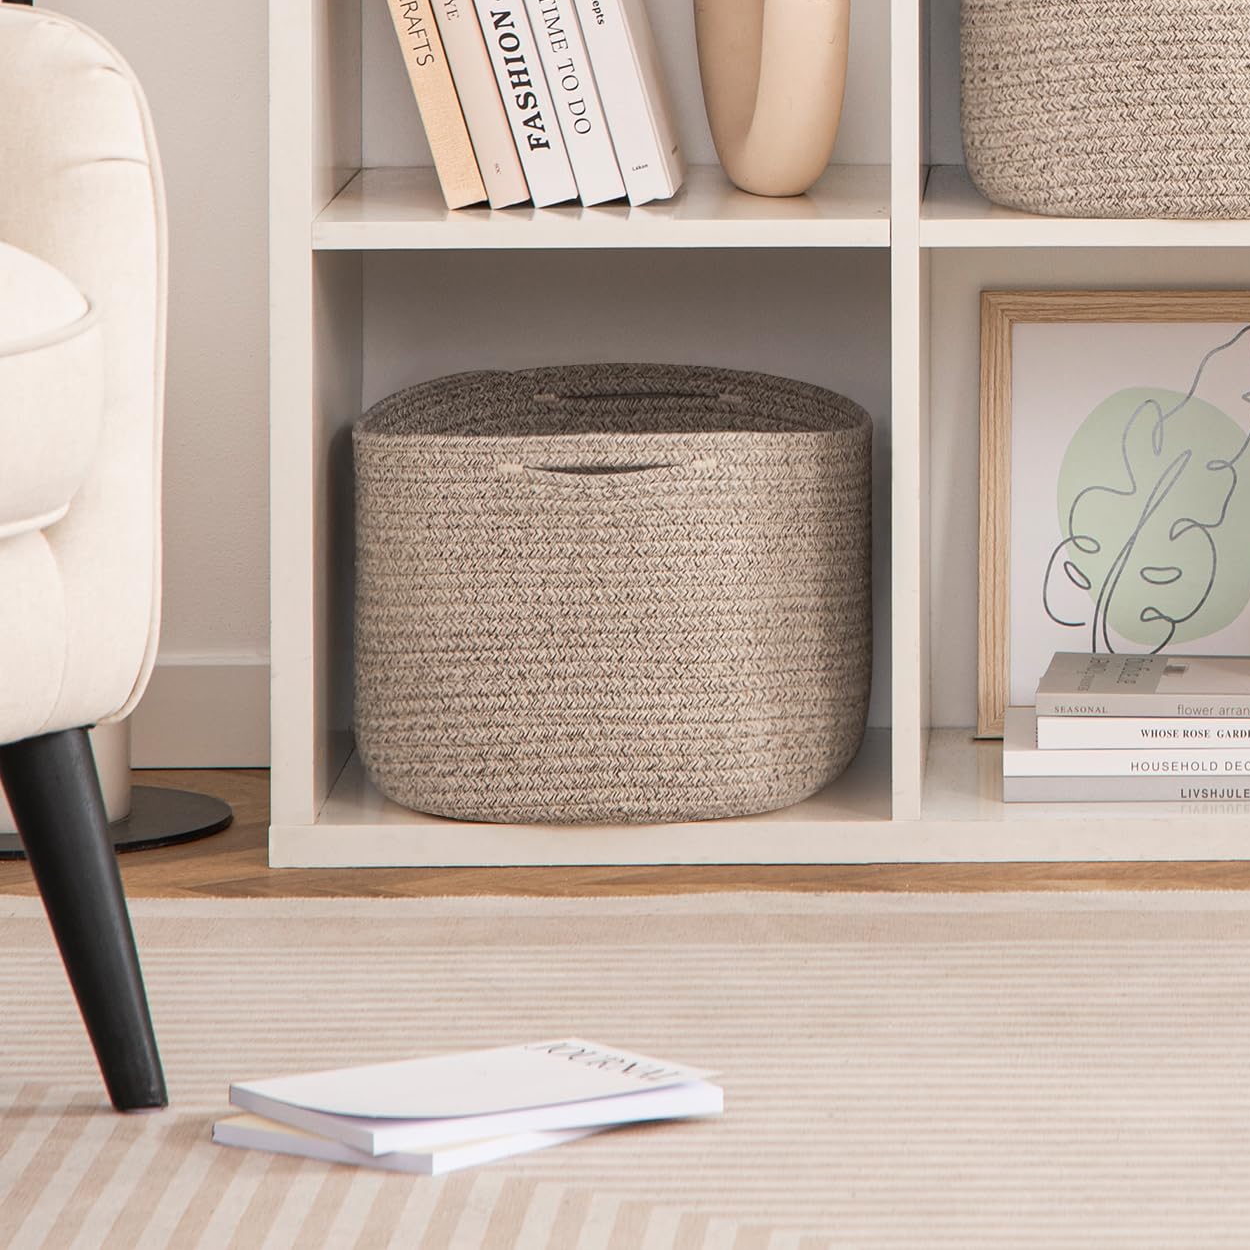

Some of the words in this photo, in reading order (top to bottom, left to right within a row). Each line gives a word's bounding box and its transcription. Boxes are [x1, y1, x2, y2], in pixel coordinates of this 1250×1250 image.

[490, 9, 551, 151] FASHION
[557, 57, 579, 92] TO
[568, 98, 592, 136] DO
[1054, 706, 1108, 714] SEASONAL
[1177, 704, 1214, 716] flower
[1141, 729, 1180, 739] WHOSE
[1182, 729, 1211, 739] ROSE
[1130, 761, 1218, 772] HOUSEHOLD
